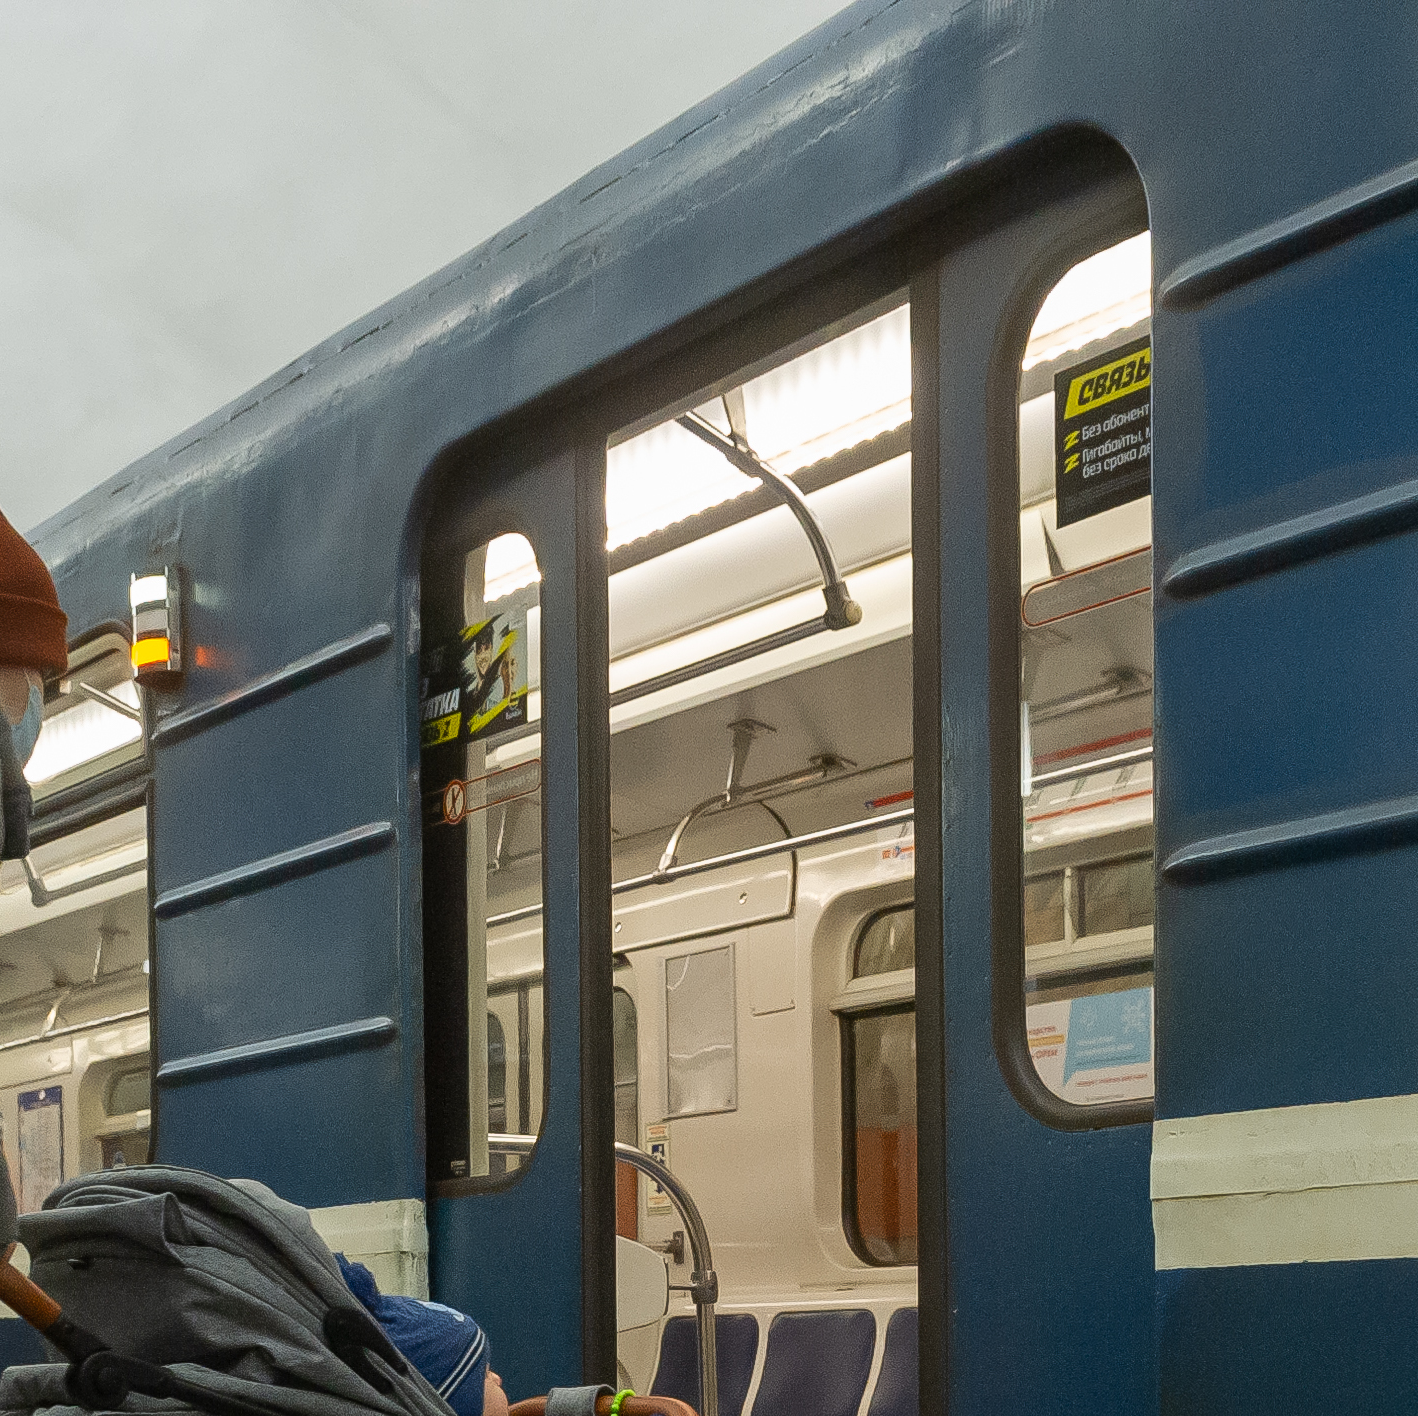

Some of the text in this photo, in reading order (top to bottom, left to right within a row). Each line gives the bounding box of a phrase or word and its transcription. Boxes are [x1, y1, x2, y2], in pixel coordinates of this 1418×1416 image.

[1078, 356, 1151, 406] СВЯЗЬ
[1082, 423, 1101, 441] Без
[1082, 461, 1102, 480] без
[1103, 447, 1137, 472] срока
